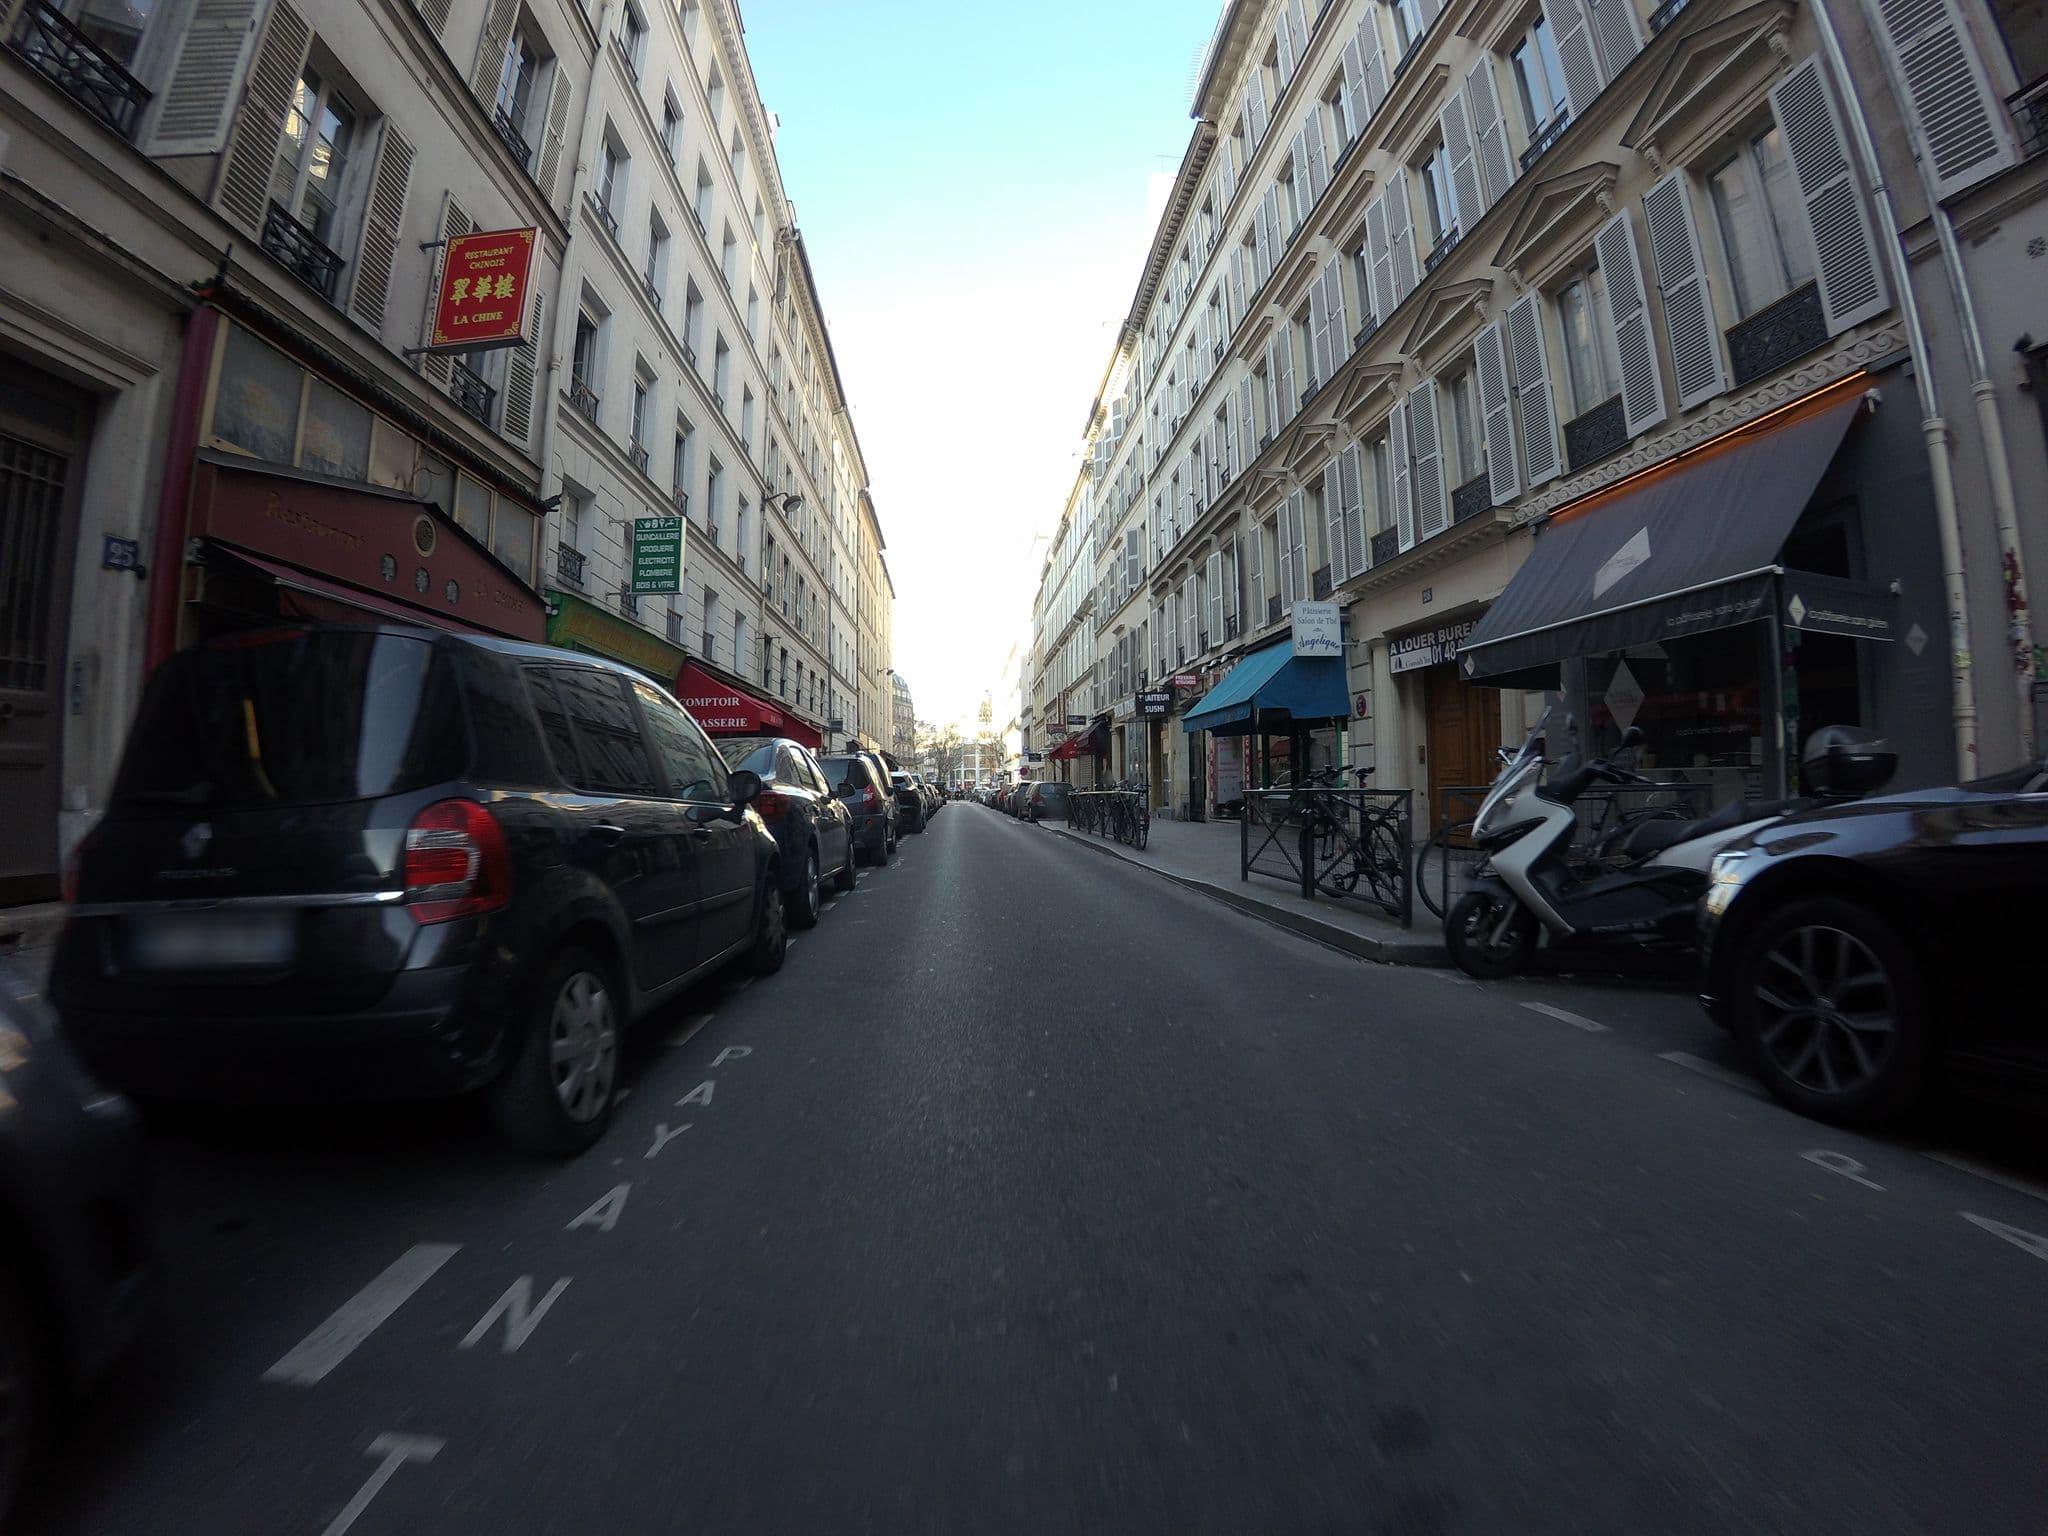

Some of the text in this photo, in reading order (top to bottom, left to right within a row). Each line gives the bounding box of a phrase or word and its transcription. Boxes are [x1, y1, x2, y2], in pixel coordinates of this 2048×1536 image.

[465, 246, 515, 260] RESTAURANT
[469, 258, 505, 270] CHINOIS
[453, 311, 503, 325] LA CHINE
[636, 532, 679, 542] QUINCAILLERIE
[640, 544, 674, 553] DROGUERIE
[110, 541, 134, 568] 25
[639, 568, 673, 577] PLOMBERIE
[635, 580, 675, 589] BOIS & VITRE
[1297, 617, 1315, 625] Salon
[1316, 617, 1324, 625] de
[1399, 632, 1436, 654] LOUER
[1432, 645, 1443, 664] 01
[1444, 641, 1457, 661] 48
[679, 697, 741, 708] COMPTOIR
[1144, 705, 1165, 713] SUSHI
